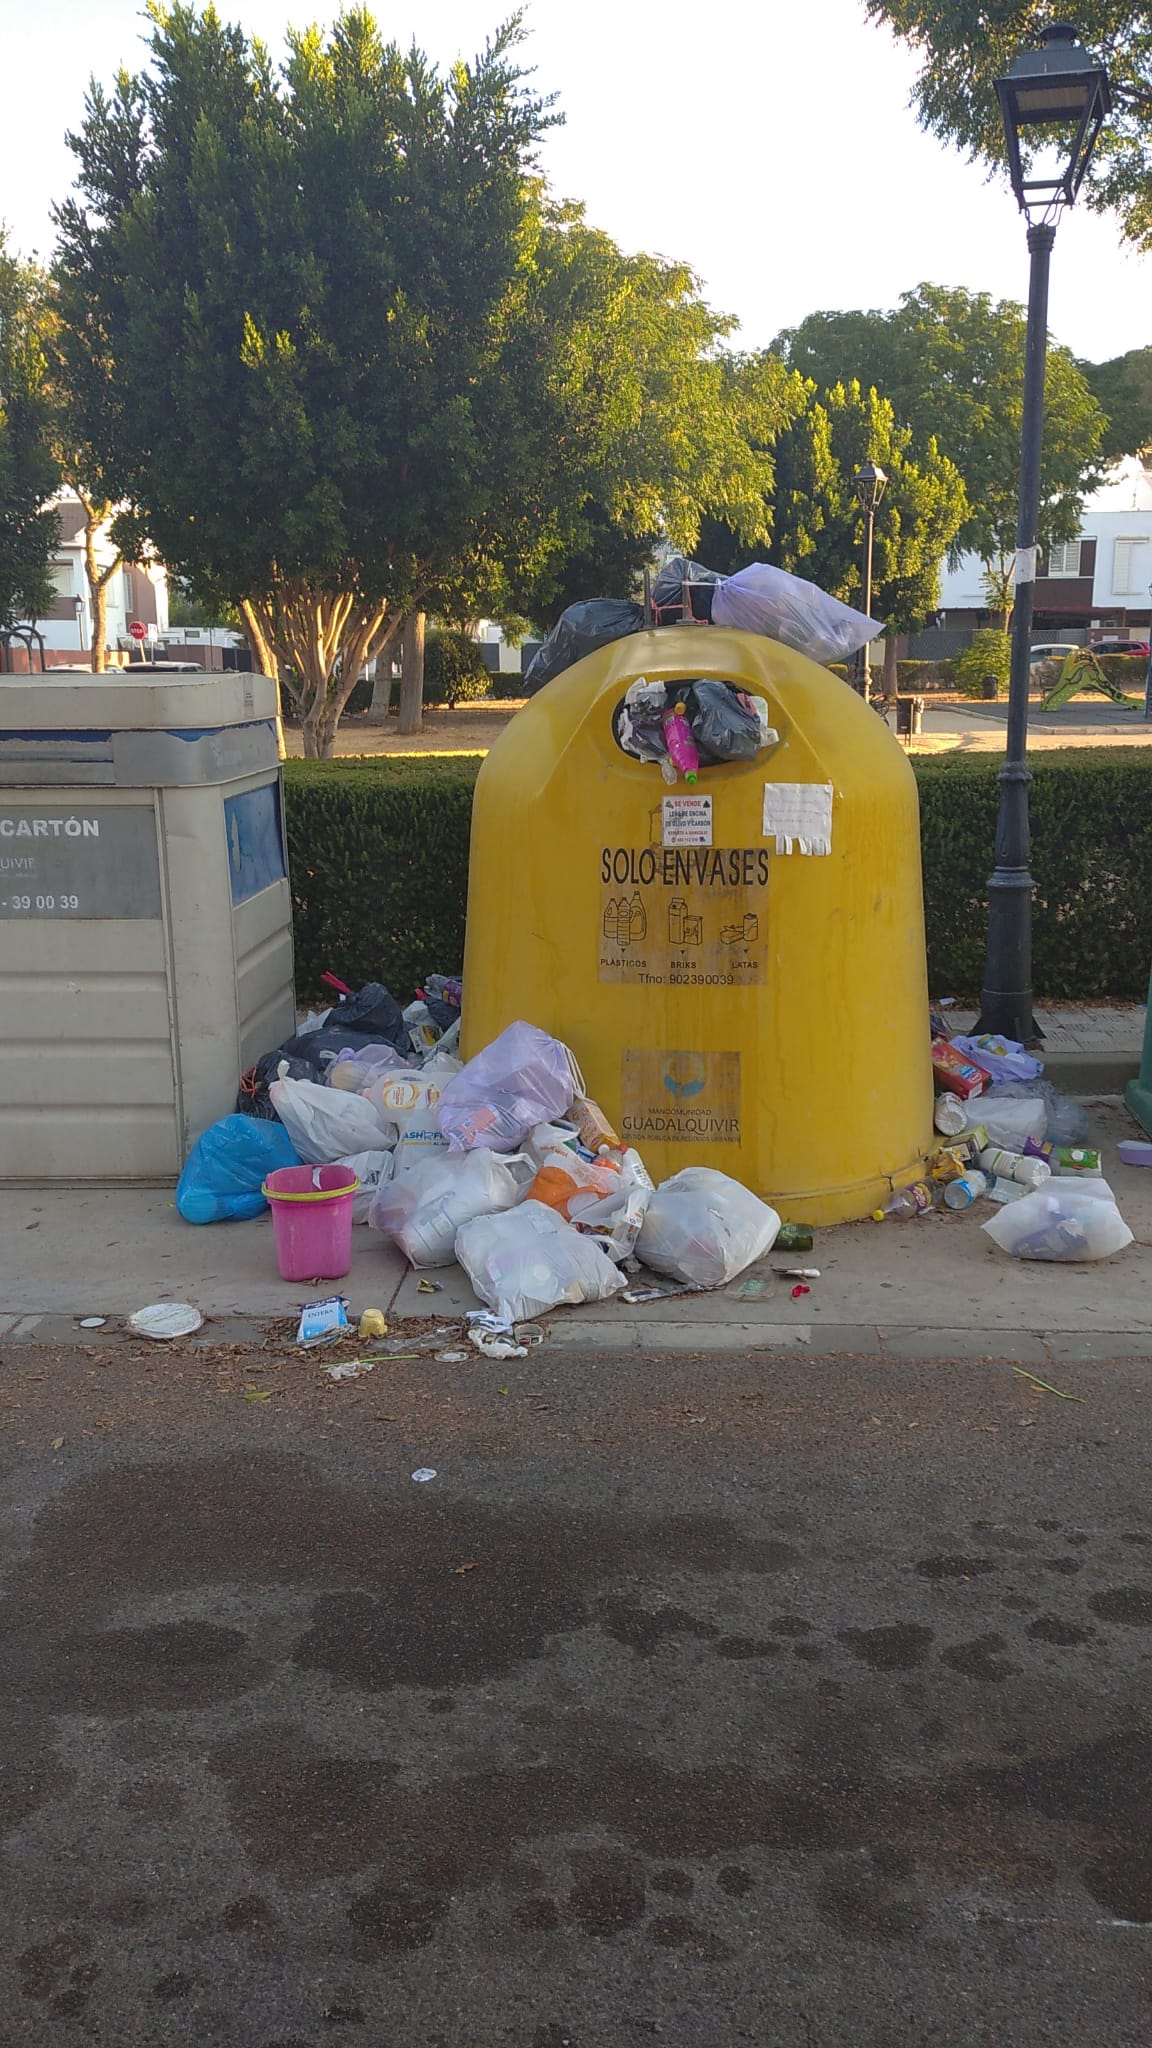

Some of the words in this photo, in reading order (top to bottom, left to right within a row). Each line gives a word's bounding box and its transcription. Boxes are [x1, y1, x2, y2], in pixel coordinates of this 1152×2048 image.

[0, 815, 99, 837] CARTÓN
[601, 847, 656, 885] SOLO
[662, 848, 769, 886] ENVASES
[12, 895, 31, 909] 39
[36, 895, 55, 909] 00
[60, 895, 79, 909] 39
[670, 961, 697, 969] BRIKS
[731, 961, 759, 969] LATAS
[638, 973, 666, 985] Tfno:
[669, 973, 734, 985] 902390039
[648, 1107, 711, 1115] MANCOMUNIDAD
[622, 1116, 740, 1135] GUADALQUIVIR
